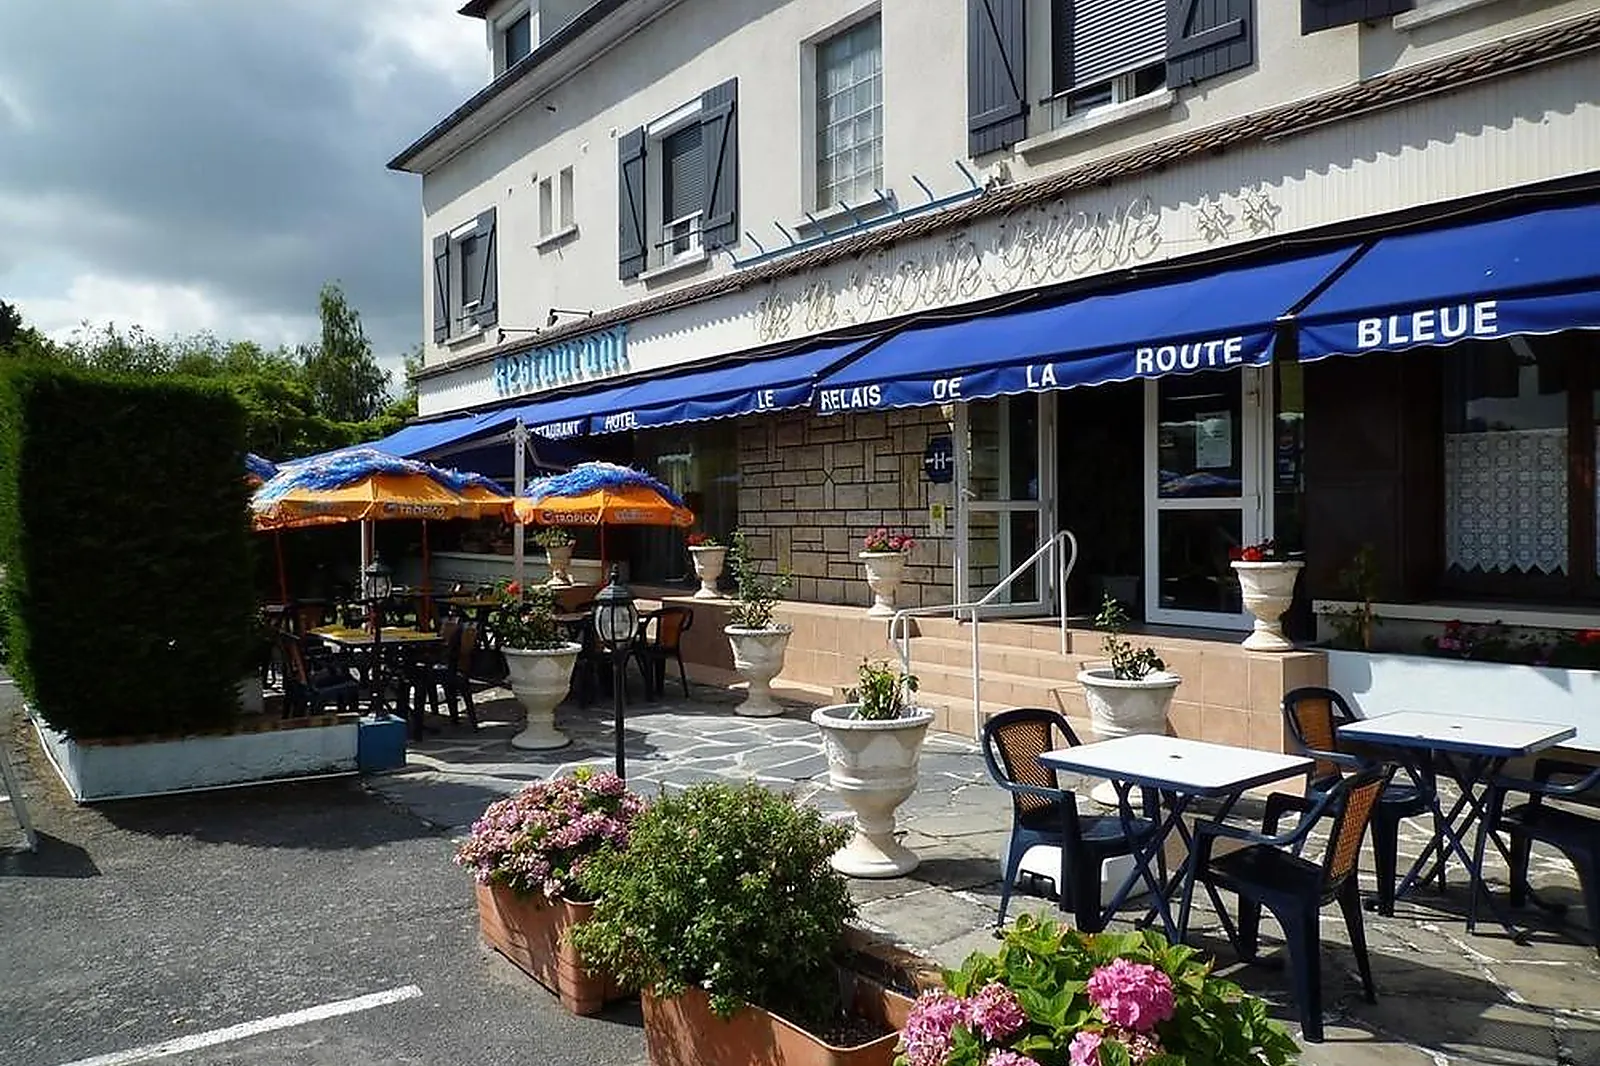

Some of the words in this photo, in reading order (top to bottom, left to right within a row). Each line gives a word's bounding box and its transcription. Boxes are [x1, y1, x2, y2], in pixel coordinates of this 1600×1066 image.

[604, 411, 638, 429] HOTEL
[757, 390, 774, 409] LE
[820, 385, 881, 410] RELAIS
[933, 377, 963, 399] DE
[1026, 364, 1057, 388] LA
[1136, 337, 1243, 374] ROUTE
[1357, 300, 1499, 348] BLEUE
